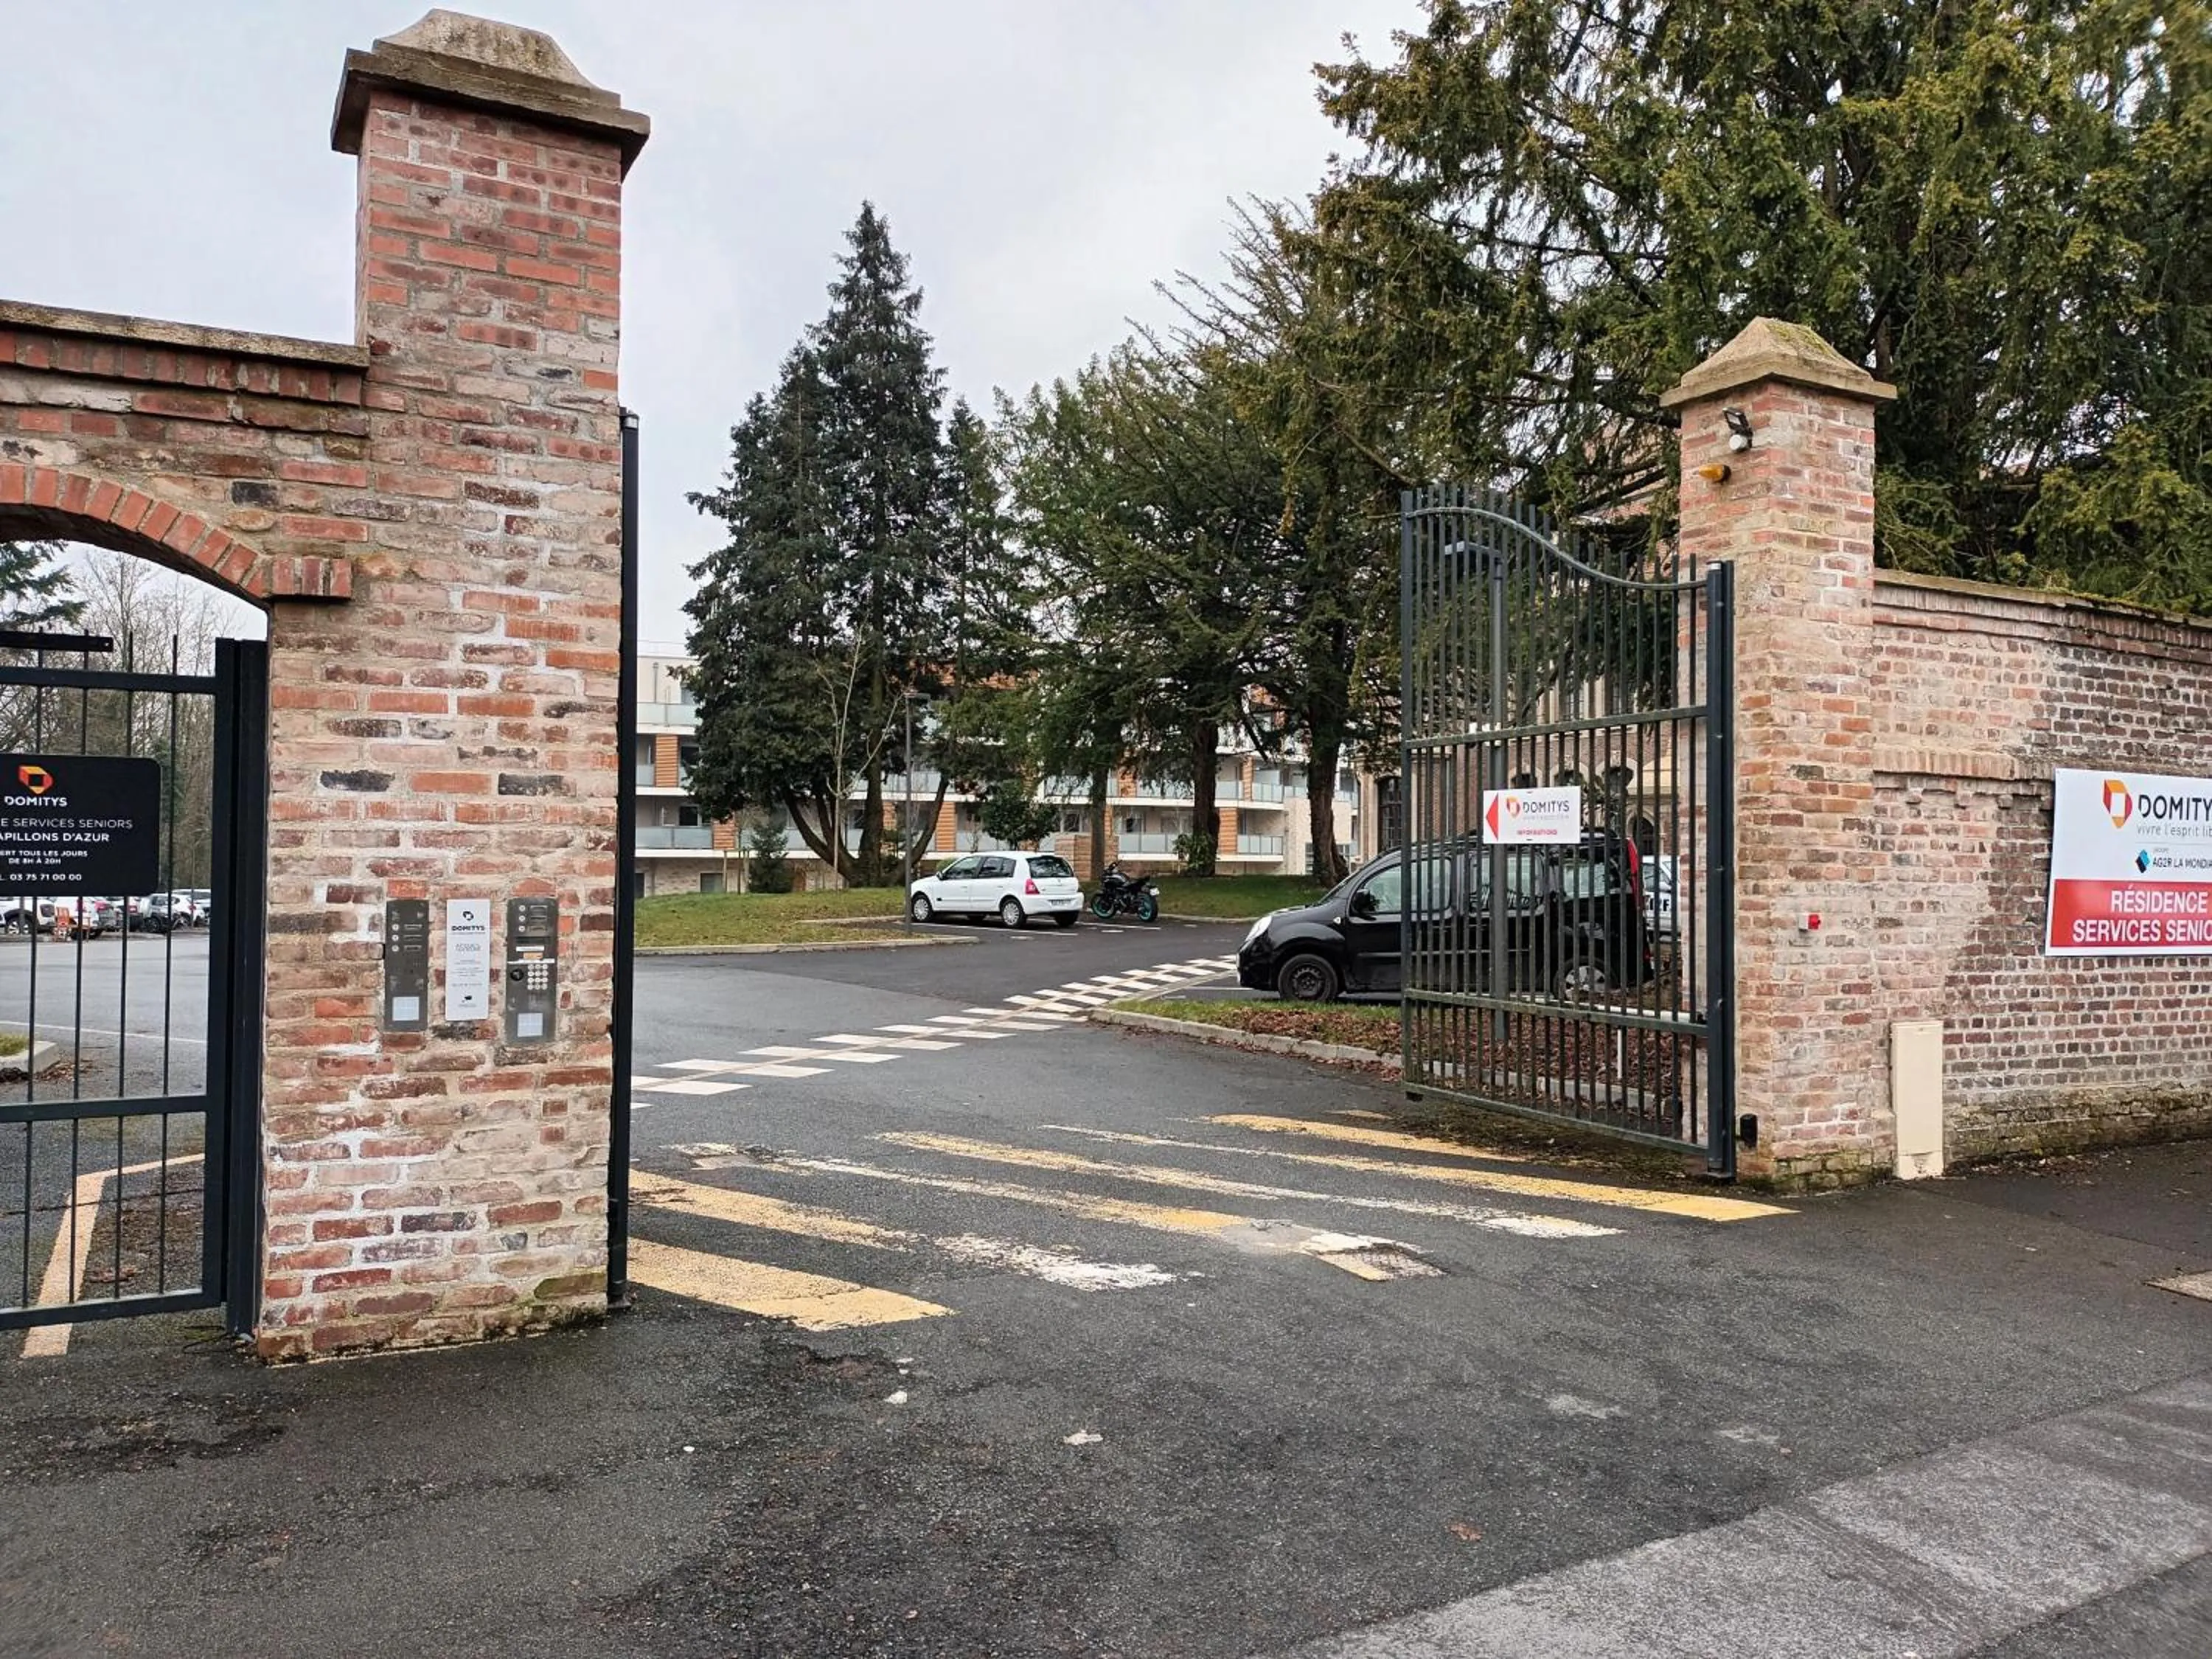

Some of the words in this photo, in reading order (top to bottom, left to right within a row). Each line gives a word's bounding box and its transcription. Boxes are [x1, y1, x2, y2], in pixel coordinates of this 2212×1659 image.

[4, 796, 68, 807] DOMITYS
[1523, 800, 1570, 813] DOMITYS
[2138, 794, 2212, 821] DOMITY
[13, 818, 74, 828] SERVICES
[79, 819, 133, 830] SENIORS
[63, 832, 110, 842] D'AZUR
[2137, 825, 2161, 835] vivre
[2164, 824, 2200, 838] l'esprit
[2153, 857, 2172, 868] AG2R
[2174, 858, 2183, 868] LA
[10, 873, 23, 881] 03
[25, 873, 38, 881] 75
[40, 873, 50, 881] 71
[52, 873, 66, 881] 00
[69, 873, 83, 881] 00
[2110, 883, 2208, 914] RÉSIDENCE
[2073, 919, 2161, 942] SERVICES
